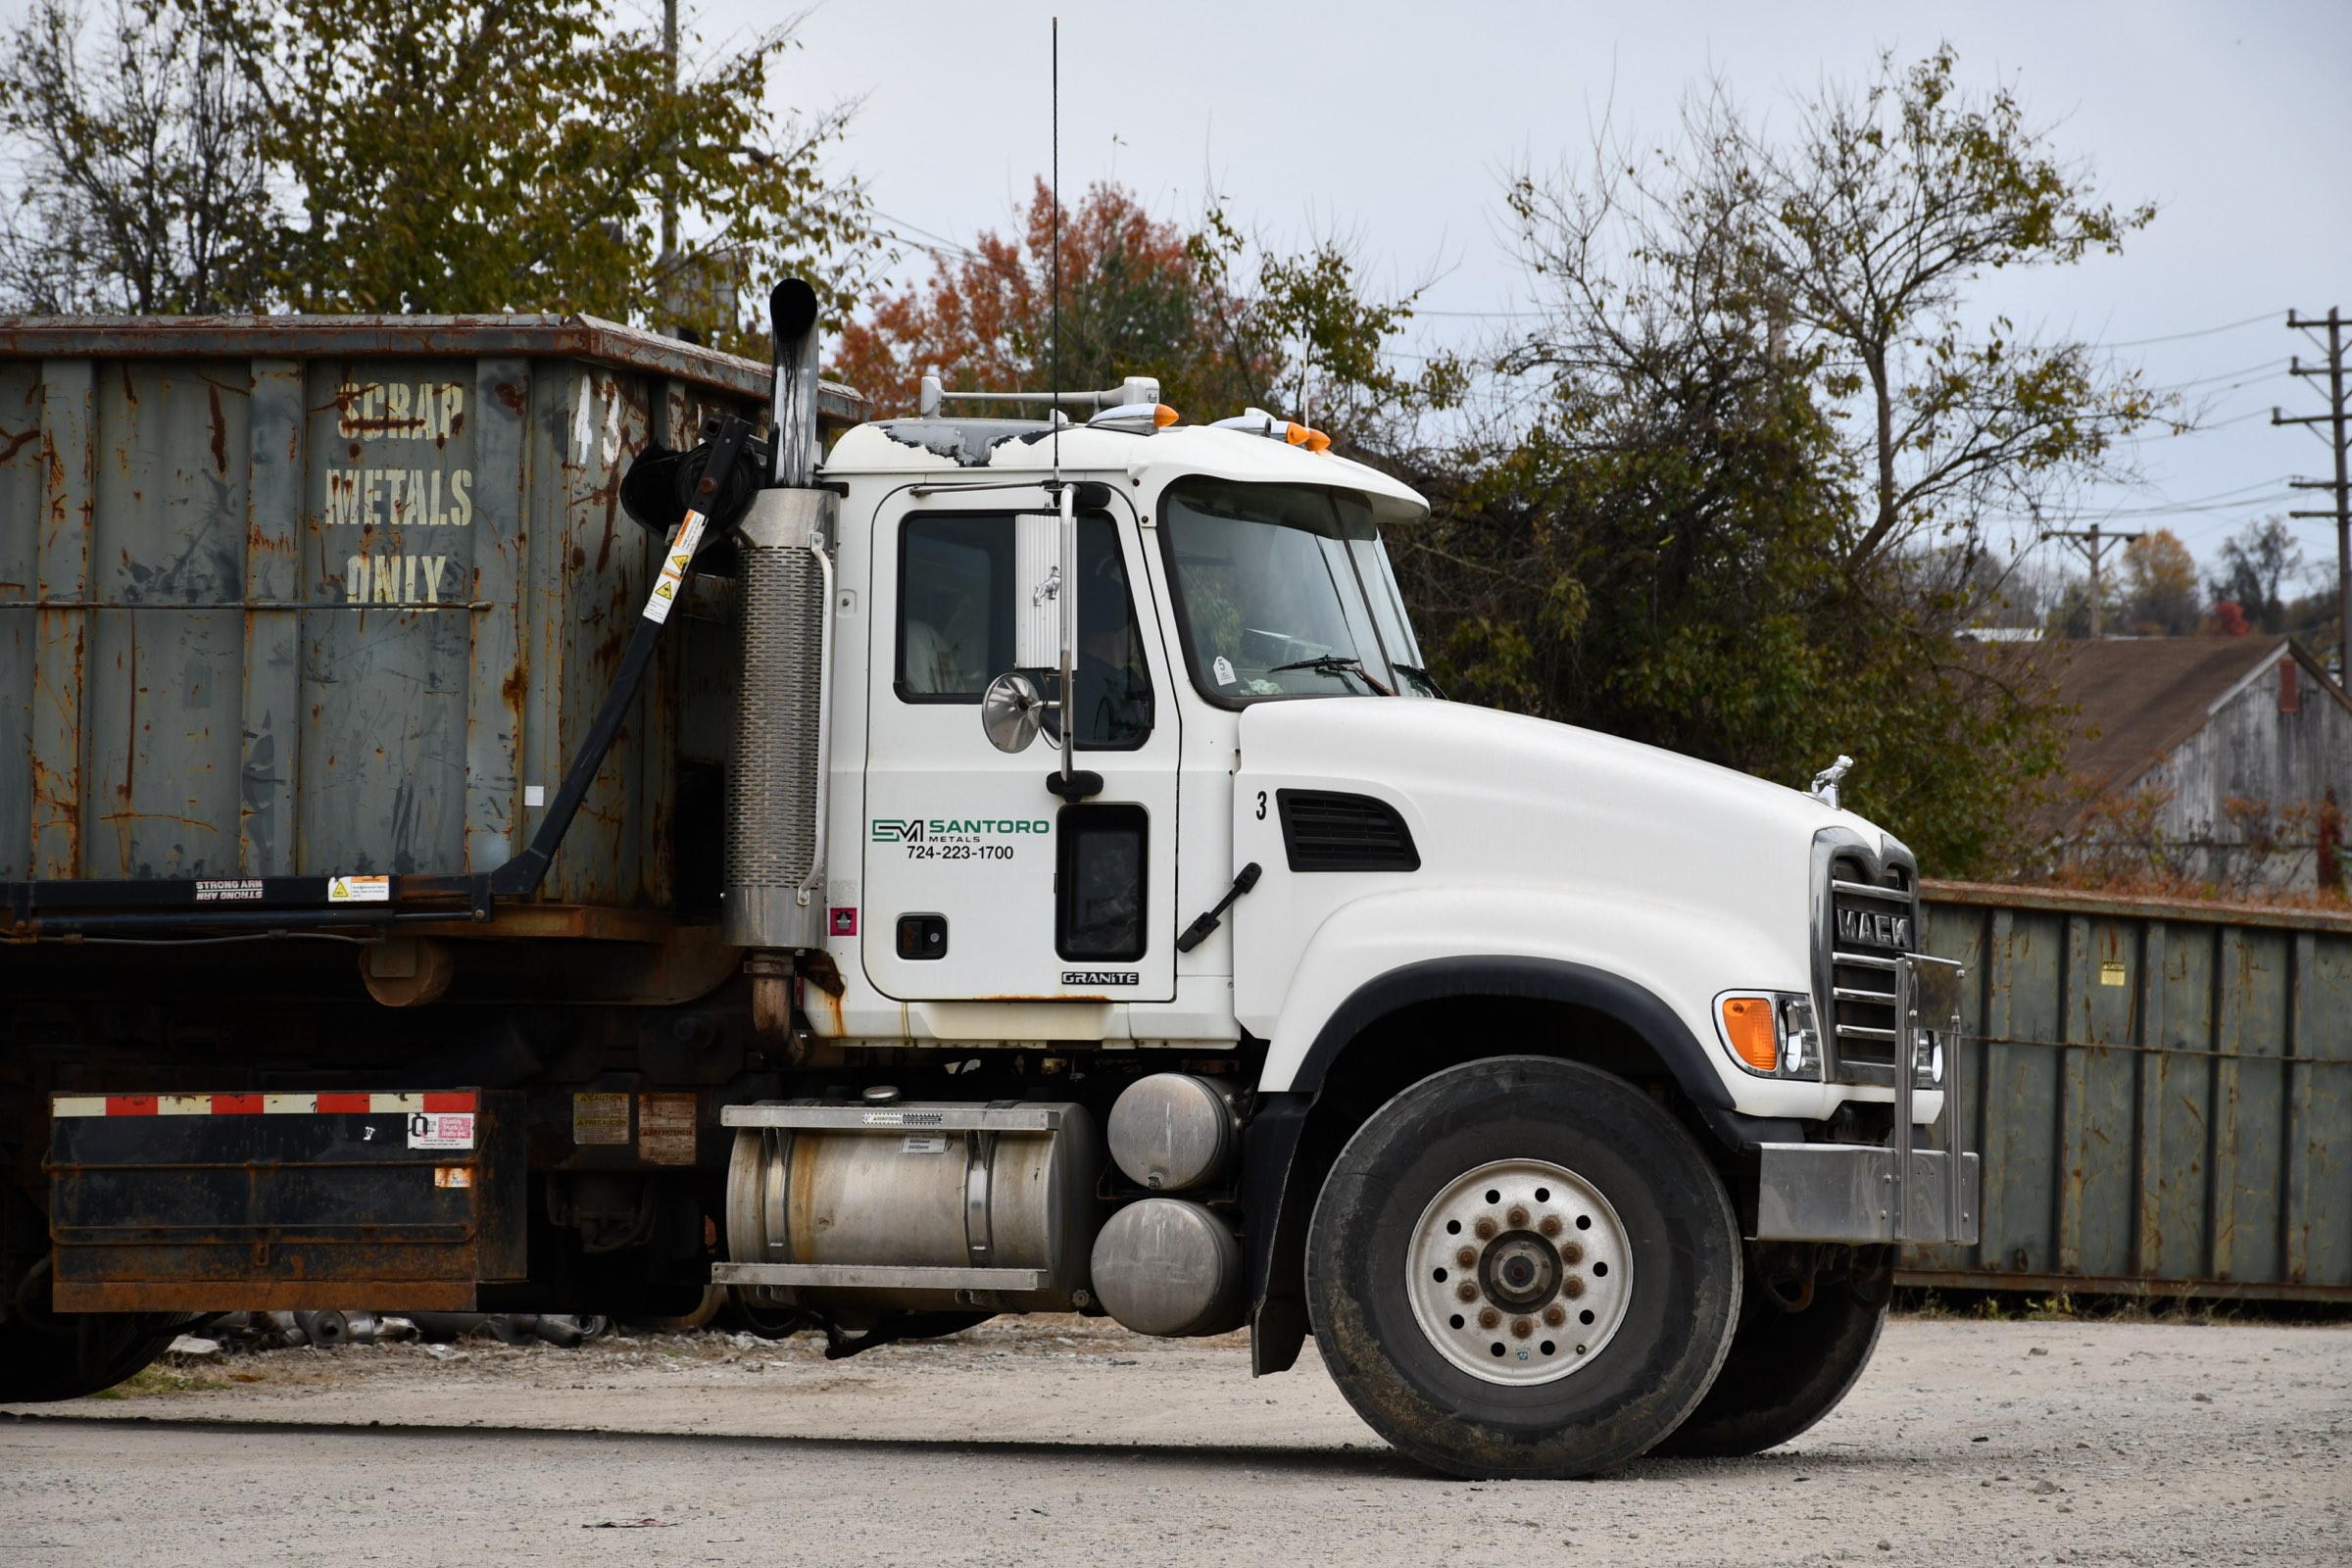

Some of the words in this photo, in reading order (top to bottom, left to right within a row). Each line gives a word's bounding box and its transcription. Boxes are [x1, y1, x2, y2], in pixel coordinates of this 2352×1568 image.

[337, 381, 464, 442] SCRAP
[325, 468, 473, 526] METALS
[346, 554, 447, 612] ONLY
[1217, 658, 1226, 671] 5
[1255, 790, 1267, 821] 3
[928, 819, 1050, 834] SANTORO
[906, 846, 1014, 860] 724-223-1700
[196, 880, 239, 890] STRONG
[240, 879, 264, 889] ARM
[196, 892, 219, 901] ARM
[220, 891, 263, 900] STRONG
[1838, 908, 1913, 951] MACK
[1062, 972, 1138, 984] GRANITE
